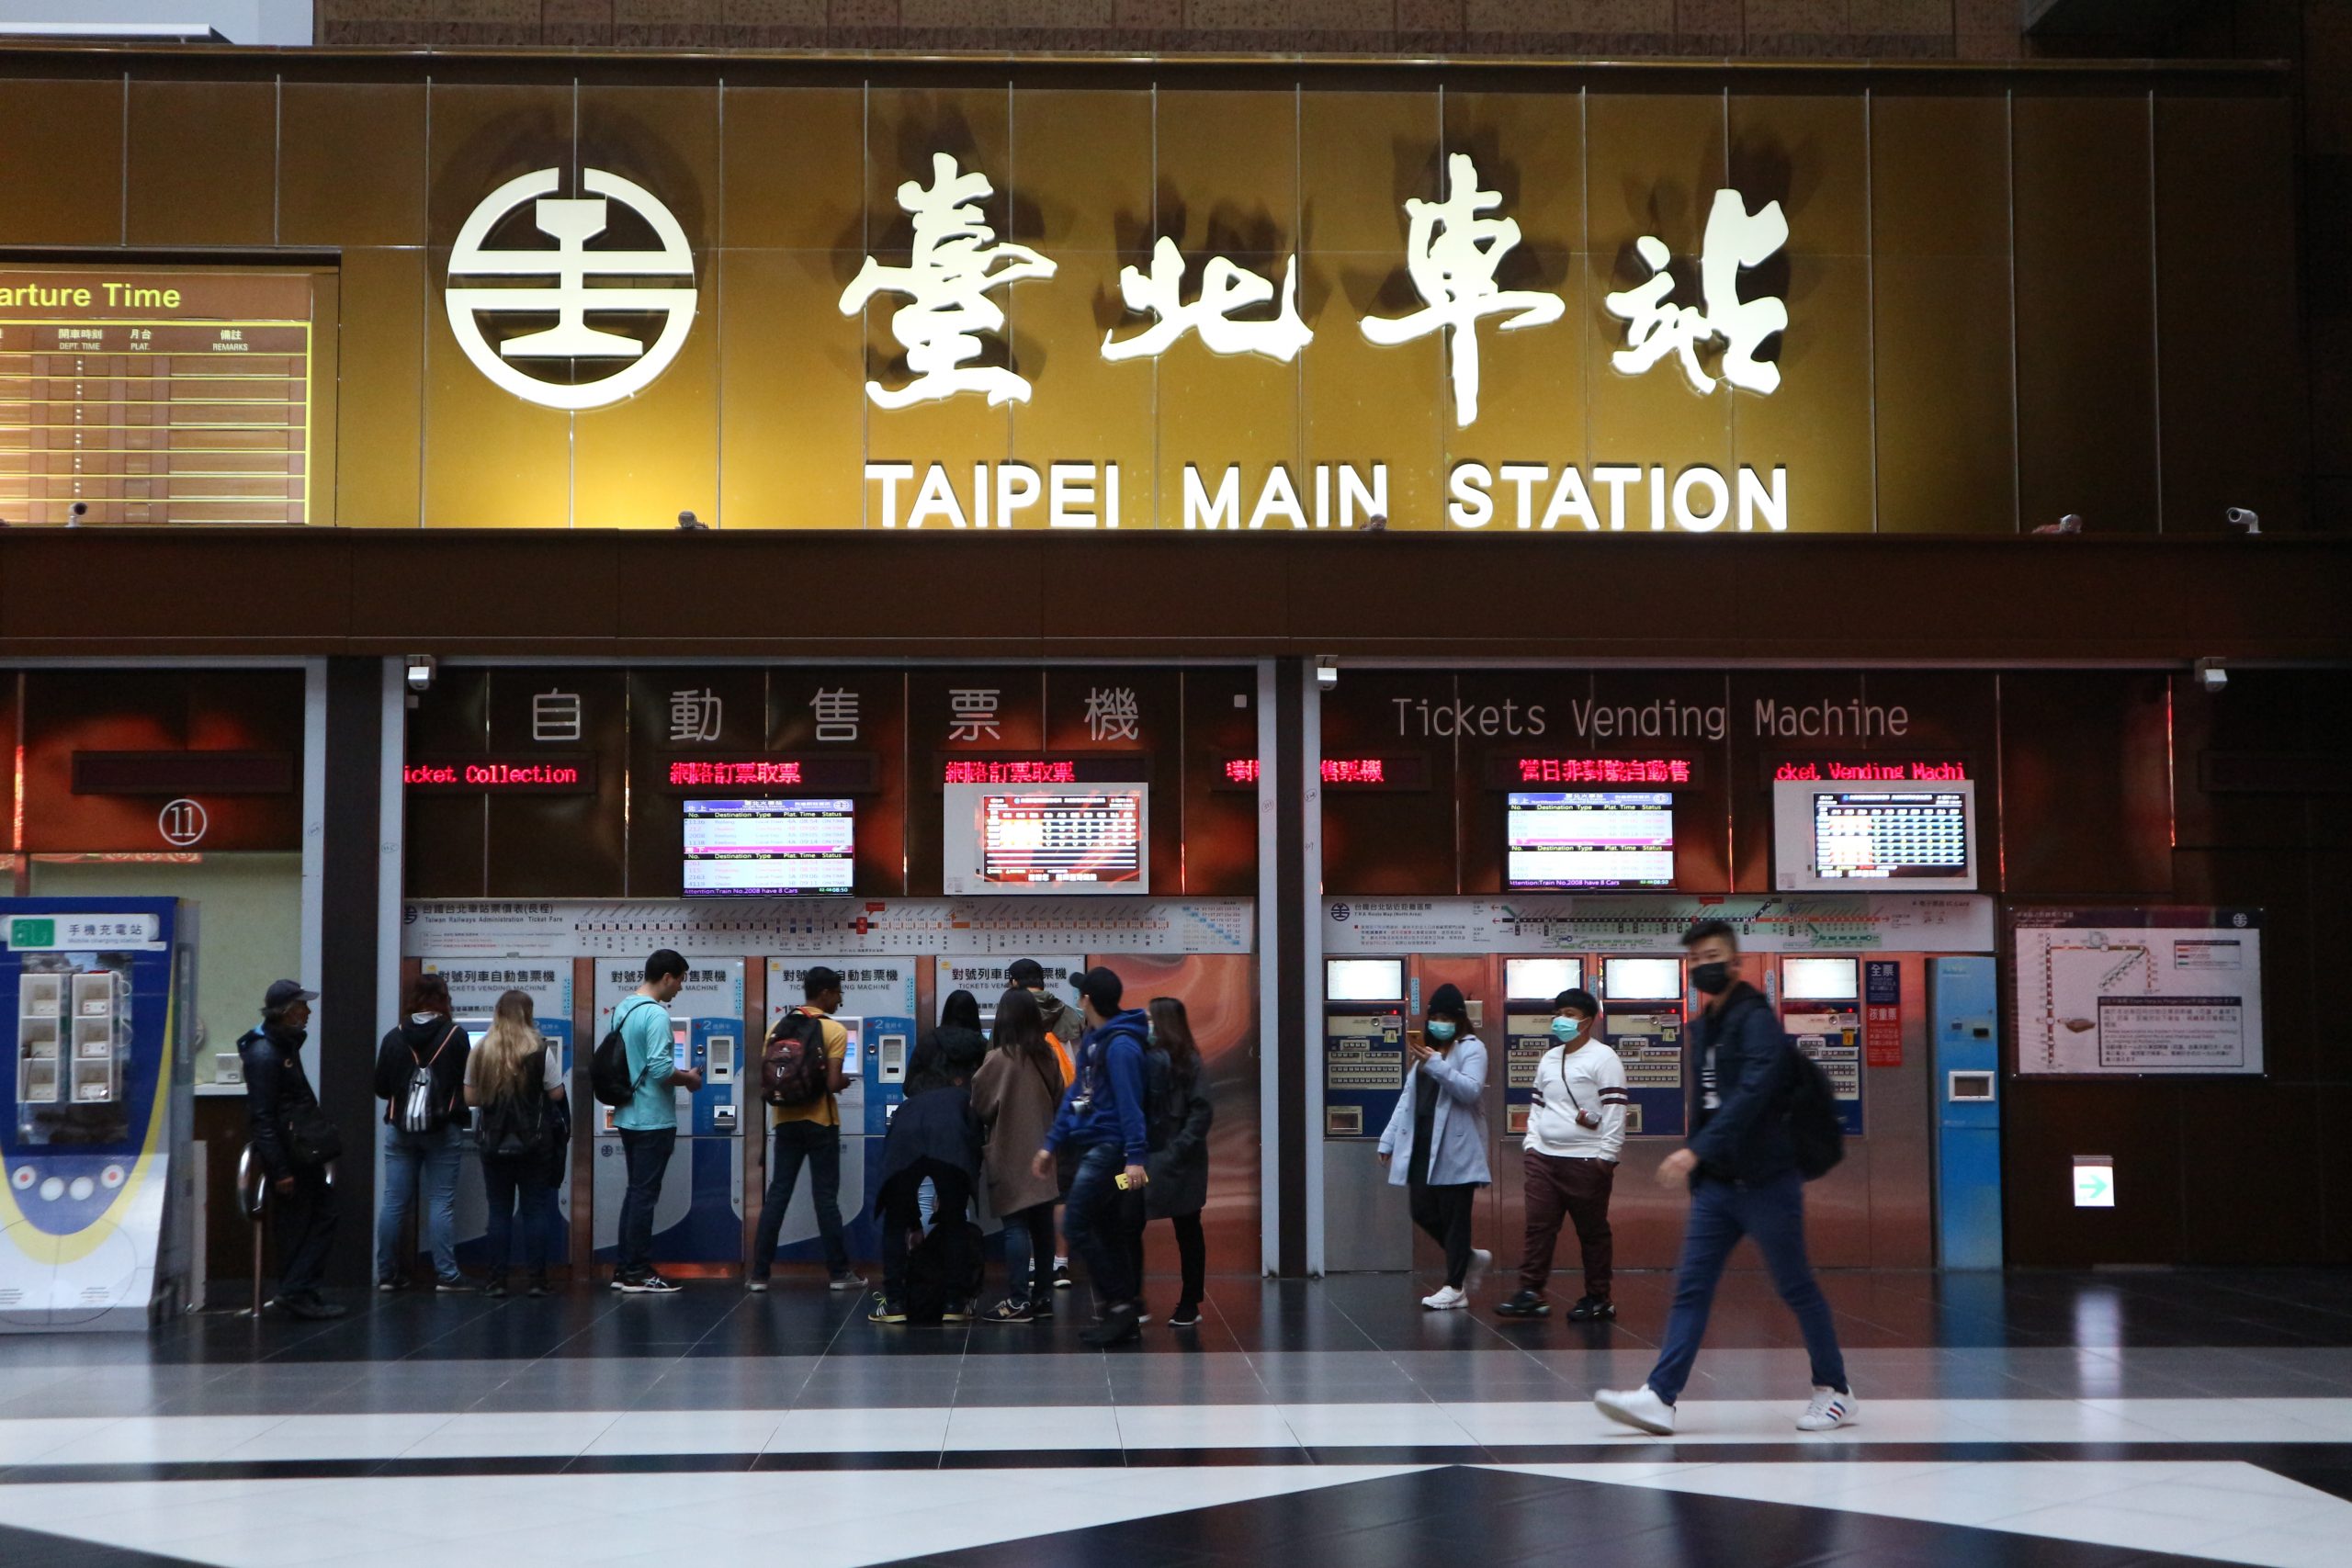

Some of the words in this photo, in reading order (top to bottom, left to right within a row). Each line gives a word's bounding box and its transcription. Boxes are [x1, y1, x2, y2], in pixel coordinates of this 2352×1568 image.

[102, 282, 181, 308] Time
[839, 153, 1788, 427] 臺北車站
[130, 329, 152, 340] 月台
[220, 329, 243, 341] 備註
[81, 342, 101, 350] TIME
[212, 343, 248, 352] REMARKS
[865, 464, 1119, 530] TAIPEI
[1183, 464, 1388, 530] MAIN
[1449, 462, 1788, 534] STATION
[533, 686, 1139, 741] 自動售票機
[1392, 697, 1545, 736] Tickets
[1572, 697, 1726, 740] Vending
[1756, 697, 1909, 737] Machine
[466, 764, 577, 784] Collection
[1828, 762, 1905, 780] Vending
[1912, 762, 1965, 780] Machi
[448, 916, 477, 924] Railways
[69, 924, 142, 935] 手機充電站
[1871, 964, 1894, 976] 全票
[703, 1021, 711, 1030] 2
[876, 1020, 883, 1029] 2
